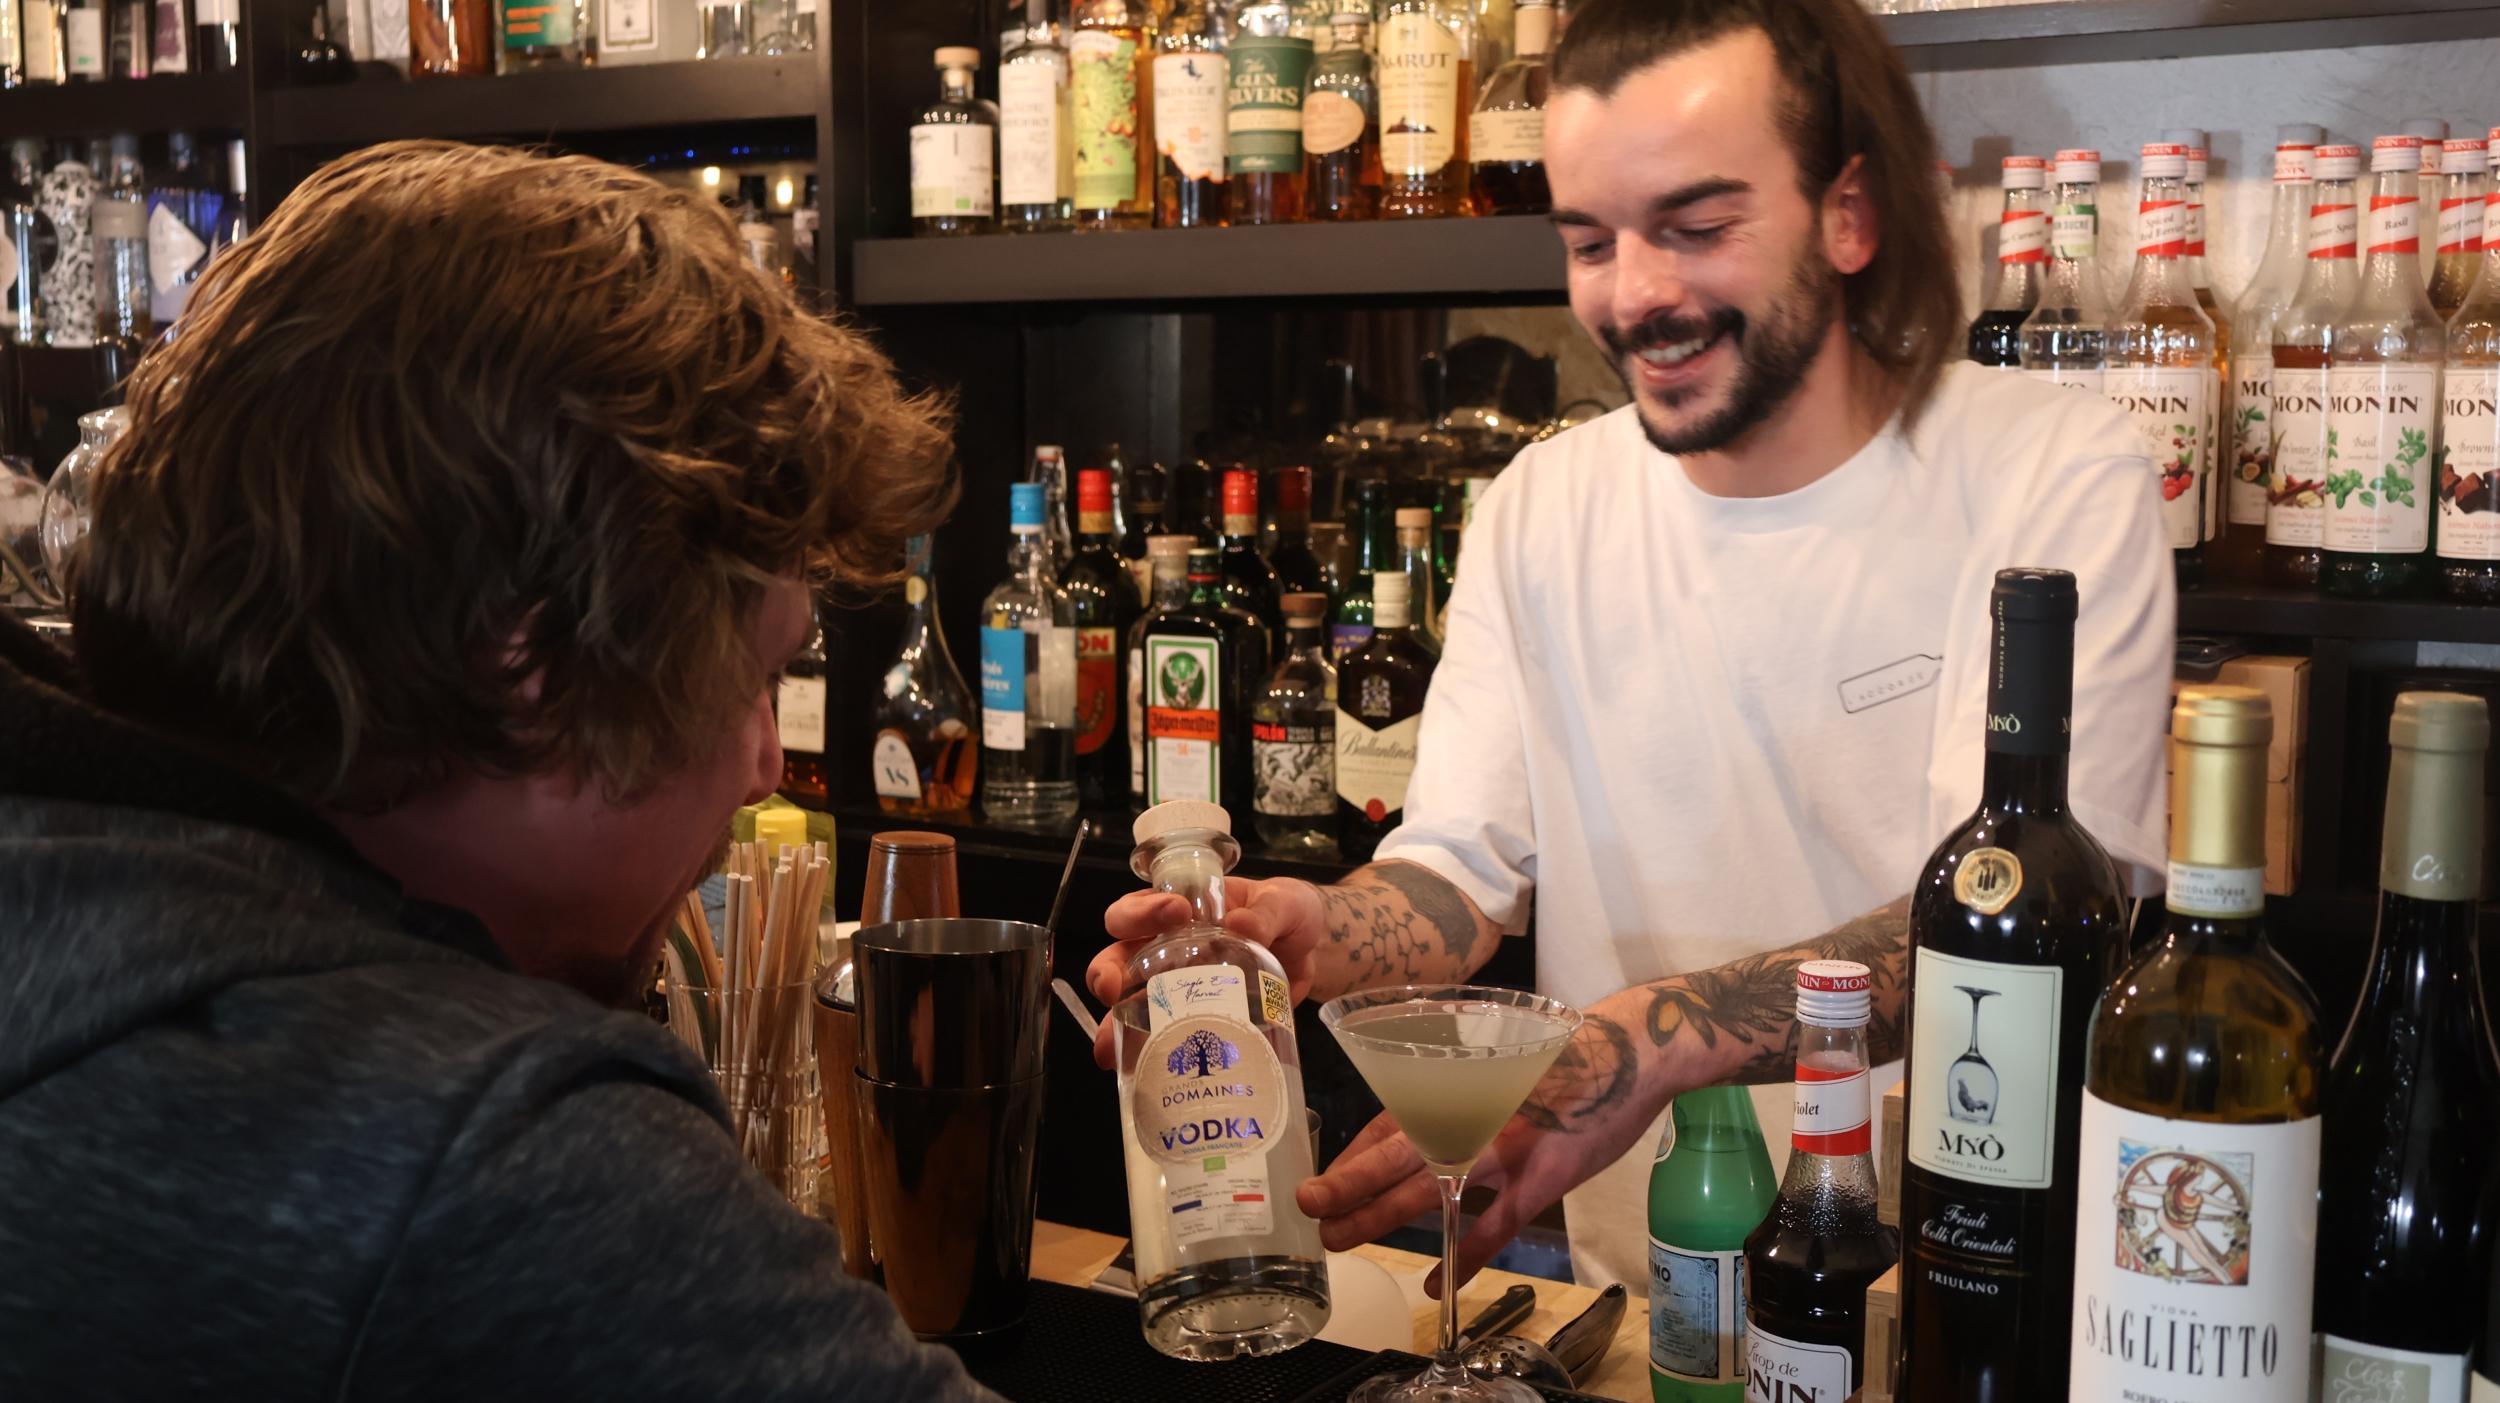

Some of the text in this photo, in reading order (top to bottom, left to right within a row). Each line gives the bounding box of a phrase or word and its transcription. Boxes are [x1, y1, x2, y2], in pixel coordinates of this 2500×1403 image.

[1235, 73, 1278, 88] GLEN
[2384, 216, 2409, 231] Basil
[2328, 396, 2420, 414] MONIN
[1171, 978, 1204, 993] Single
[1184, 988, 1224, 1003] Harvest
[1161, 1079, 1205, 1095] GRANDS
[1162, 1084, 1255, 1109] DOMAINES
[1159, 1116, 1265, 1151] VODKA
[1943, 1203, 1990, 1229] Friuli
[1921, 1218, 2018, 1255] Colli Orientali
[1928, 1269, 2000, 1296] FRIULANO
[2150, 1303, 2200, 1318] VIGNA
[2085, 1294, 2279, 1379] SAGLIETTO
[1778, 1361, 1799, 1378] de
